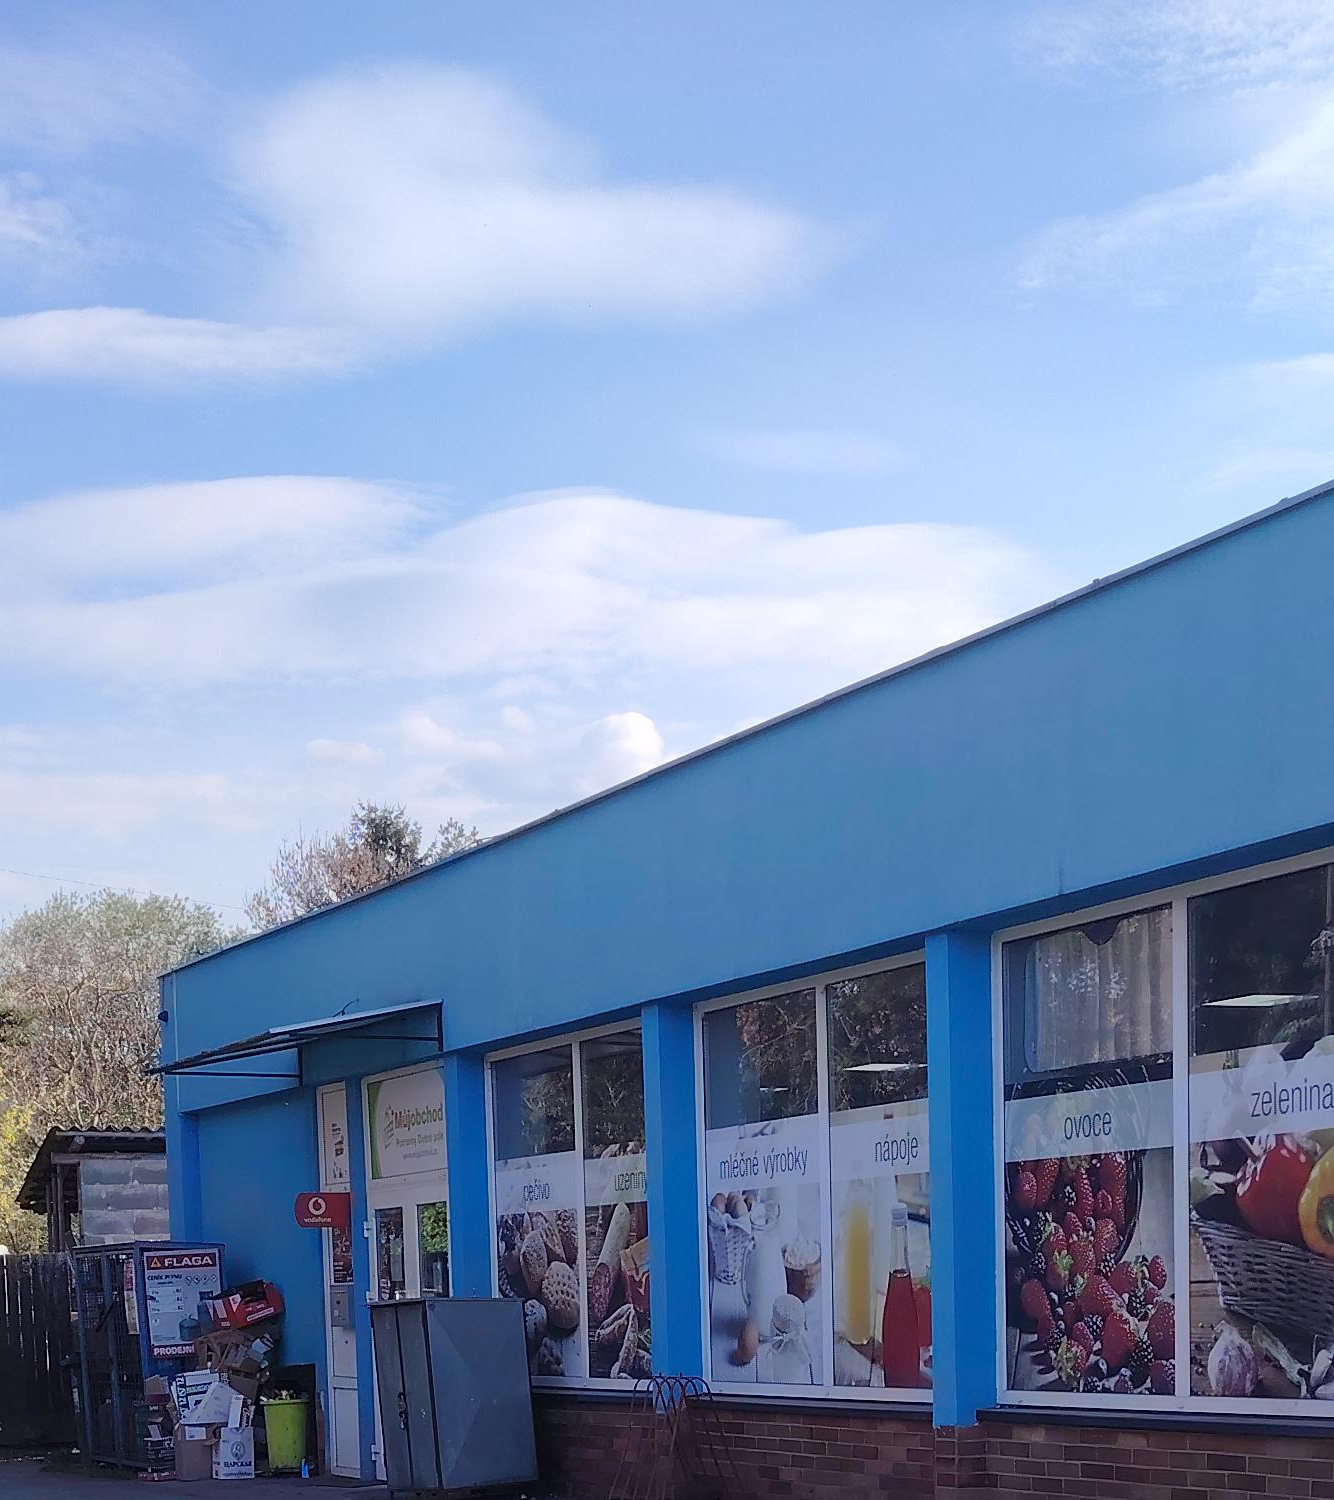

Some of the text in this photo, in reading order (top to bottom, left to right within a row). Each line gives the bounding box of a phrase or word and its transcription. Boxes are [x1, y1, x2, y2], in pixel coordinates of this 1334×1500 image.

[1251, 1077, 1334, 1119] zelenina
[1063, 1110, 1113, 1140] ovoce
[719, 1145, 809, 1181] mléčné výrobky
[874, 1131, 919, 1167] nápoje
[523, 1178, 551, 1203] pečivo
[303, 1216, 332, 1224] vodafone
[164, 1256, 214, 1268] FLAGA
